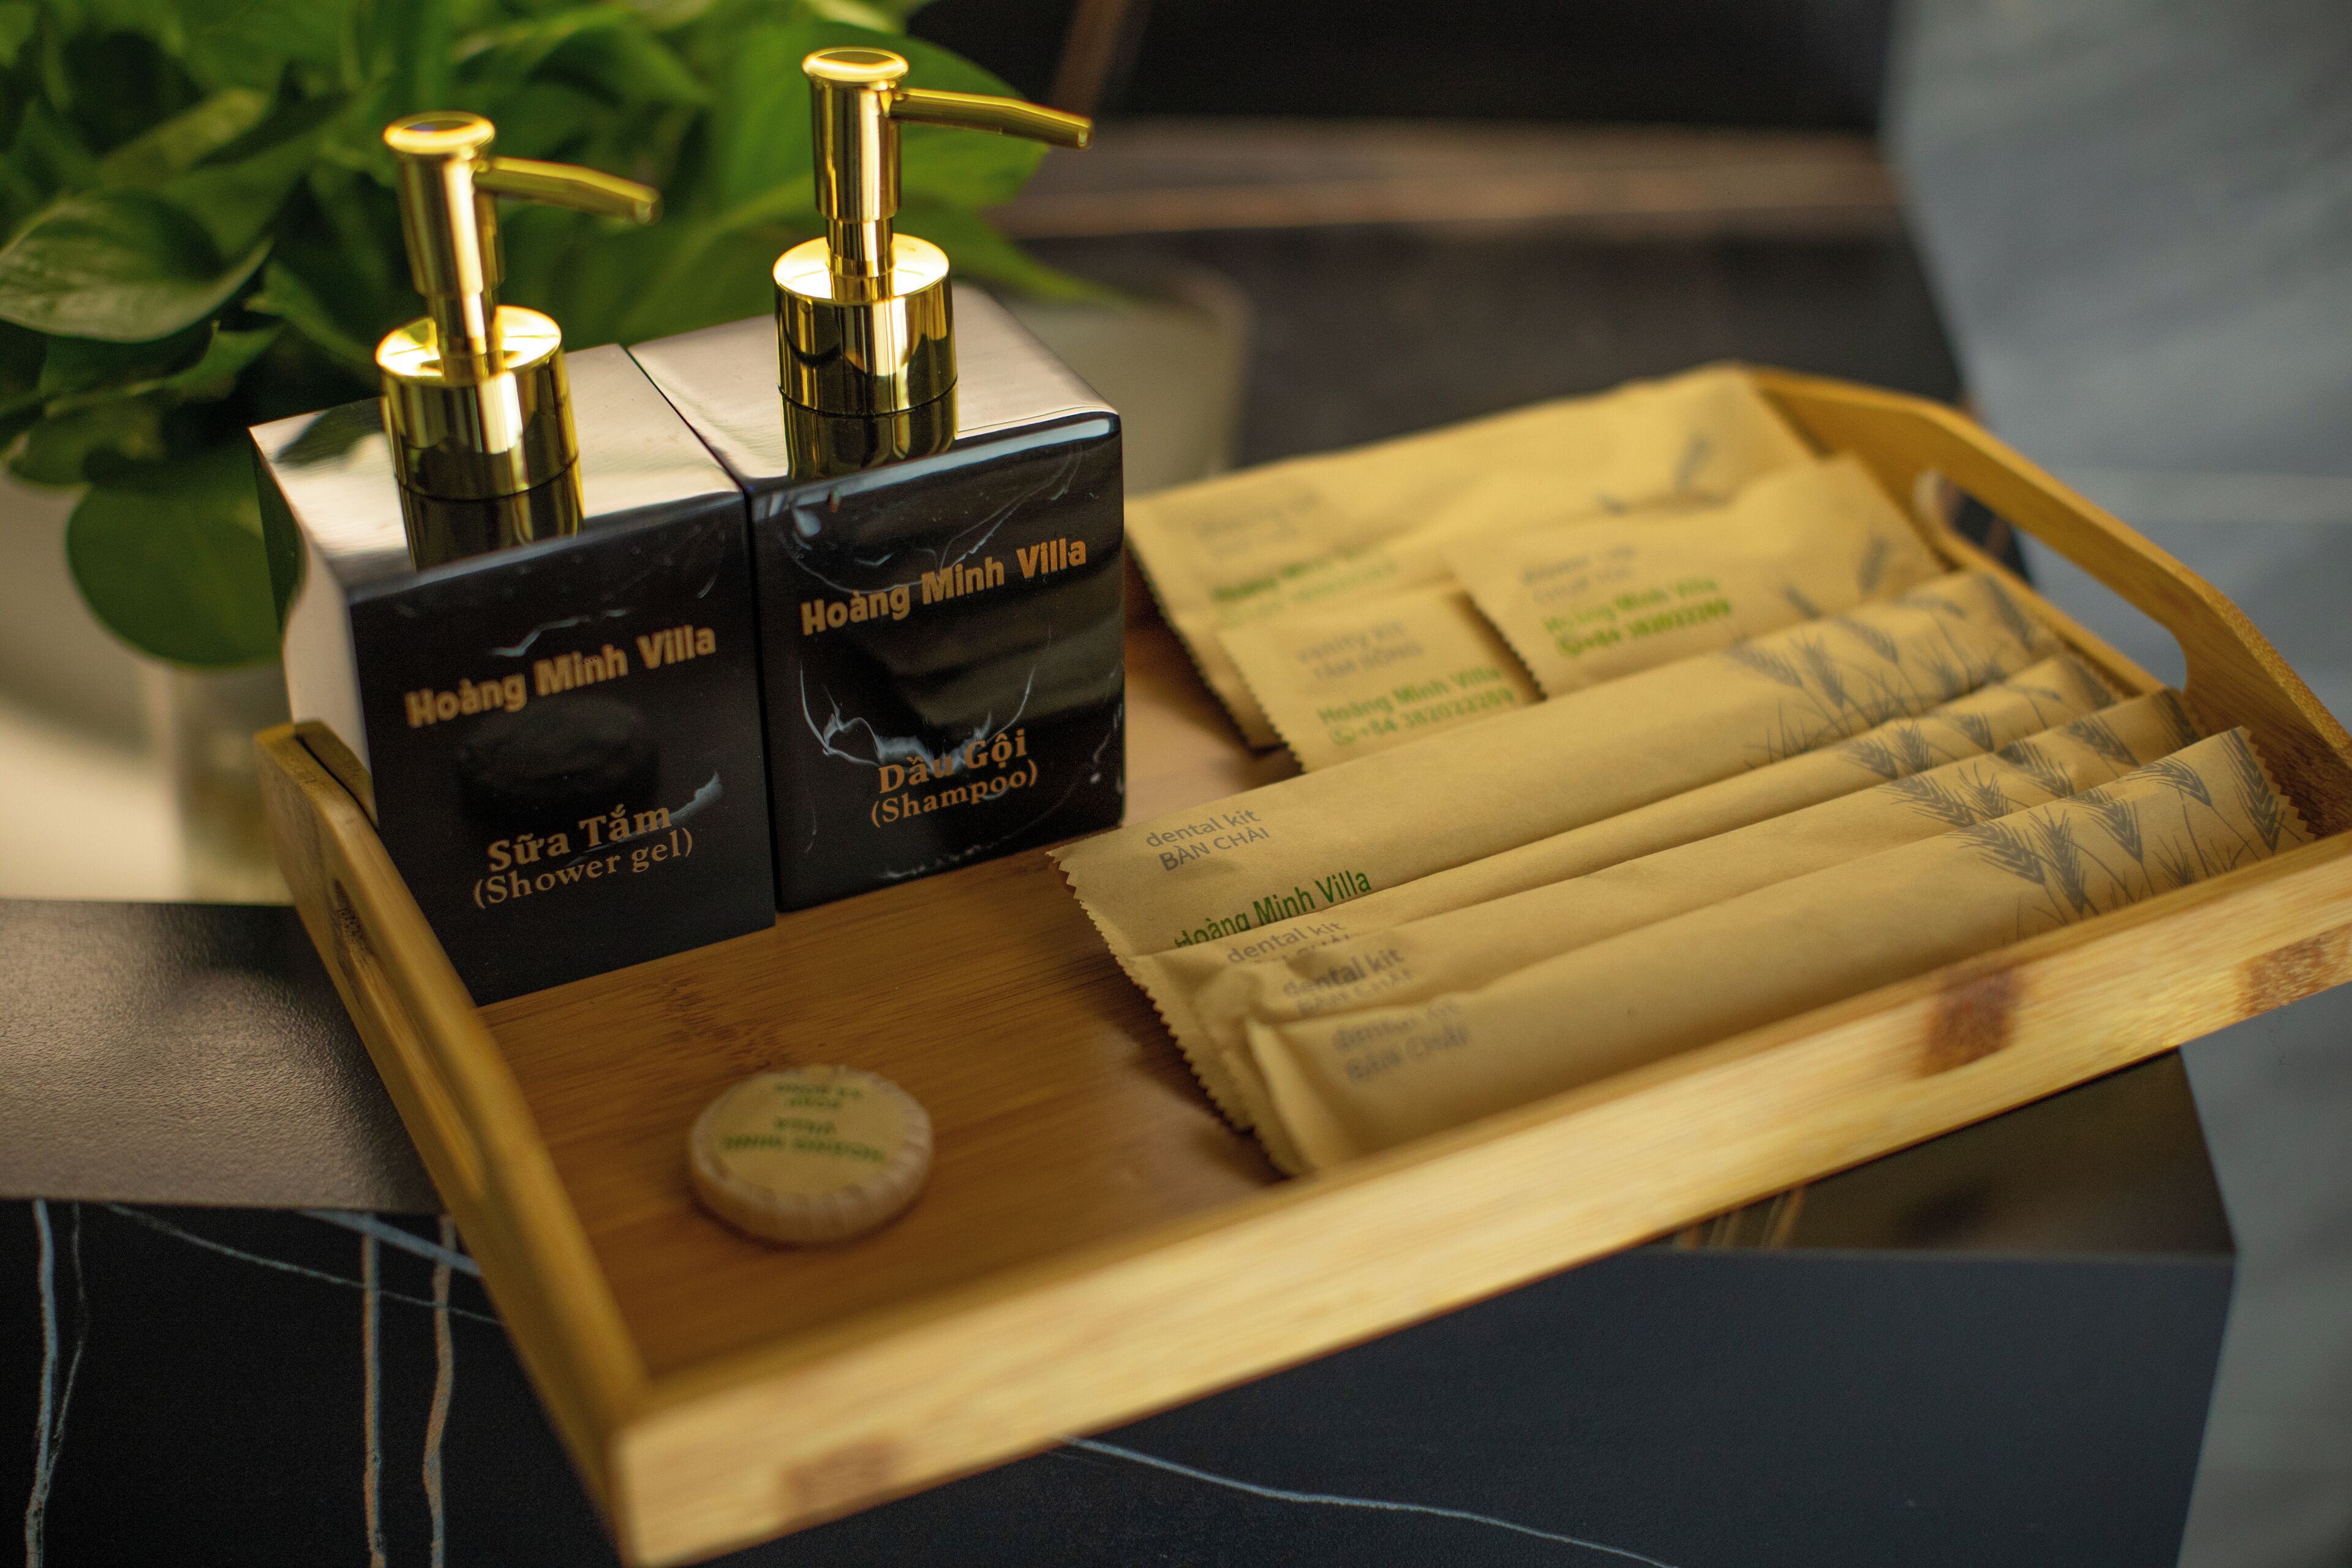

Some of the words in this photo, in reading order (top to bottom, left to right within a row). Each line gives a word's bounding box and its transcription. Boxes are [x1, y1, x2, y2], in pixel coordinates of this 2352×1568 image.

[801, 586, 911, 636] Hoàng
[921, 557, 1005, 605] Minh
[1016, 538, 1087, 579] Villa
[404, 673, 527, 728] Hoàng
[533, 644, 628, 696] Minh
[636, 624, 716, 669] Villa
[872, 759, 1038, 827] (Shampoo)
[878, 755, 954, 794] Dầu
[964, 728, 1027, 769] Gội
[487, 833, 571, 872] Sữa
[578, 803, 673, 848] Tắm
[1145, 817, 1225, 848] dental
[1222, 809, 1262, 827] kit
[1158, 841, 1212, 872] BÀN
[472, 854, 621, 910] (Shower
[631, 827, 693, 873] gel)
[1253, 886, 1316, 926] Minh
[1314, 870, 1372, 903] Villa
[1226, 927, 1308, 963] dental
[1307, 922, 1347, 936] kit
[1283, 956, 1366, 995] dental
[1364, 948, 1404, 973] kit
